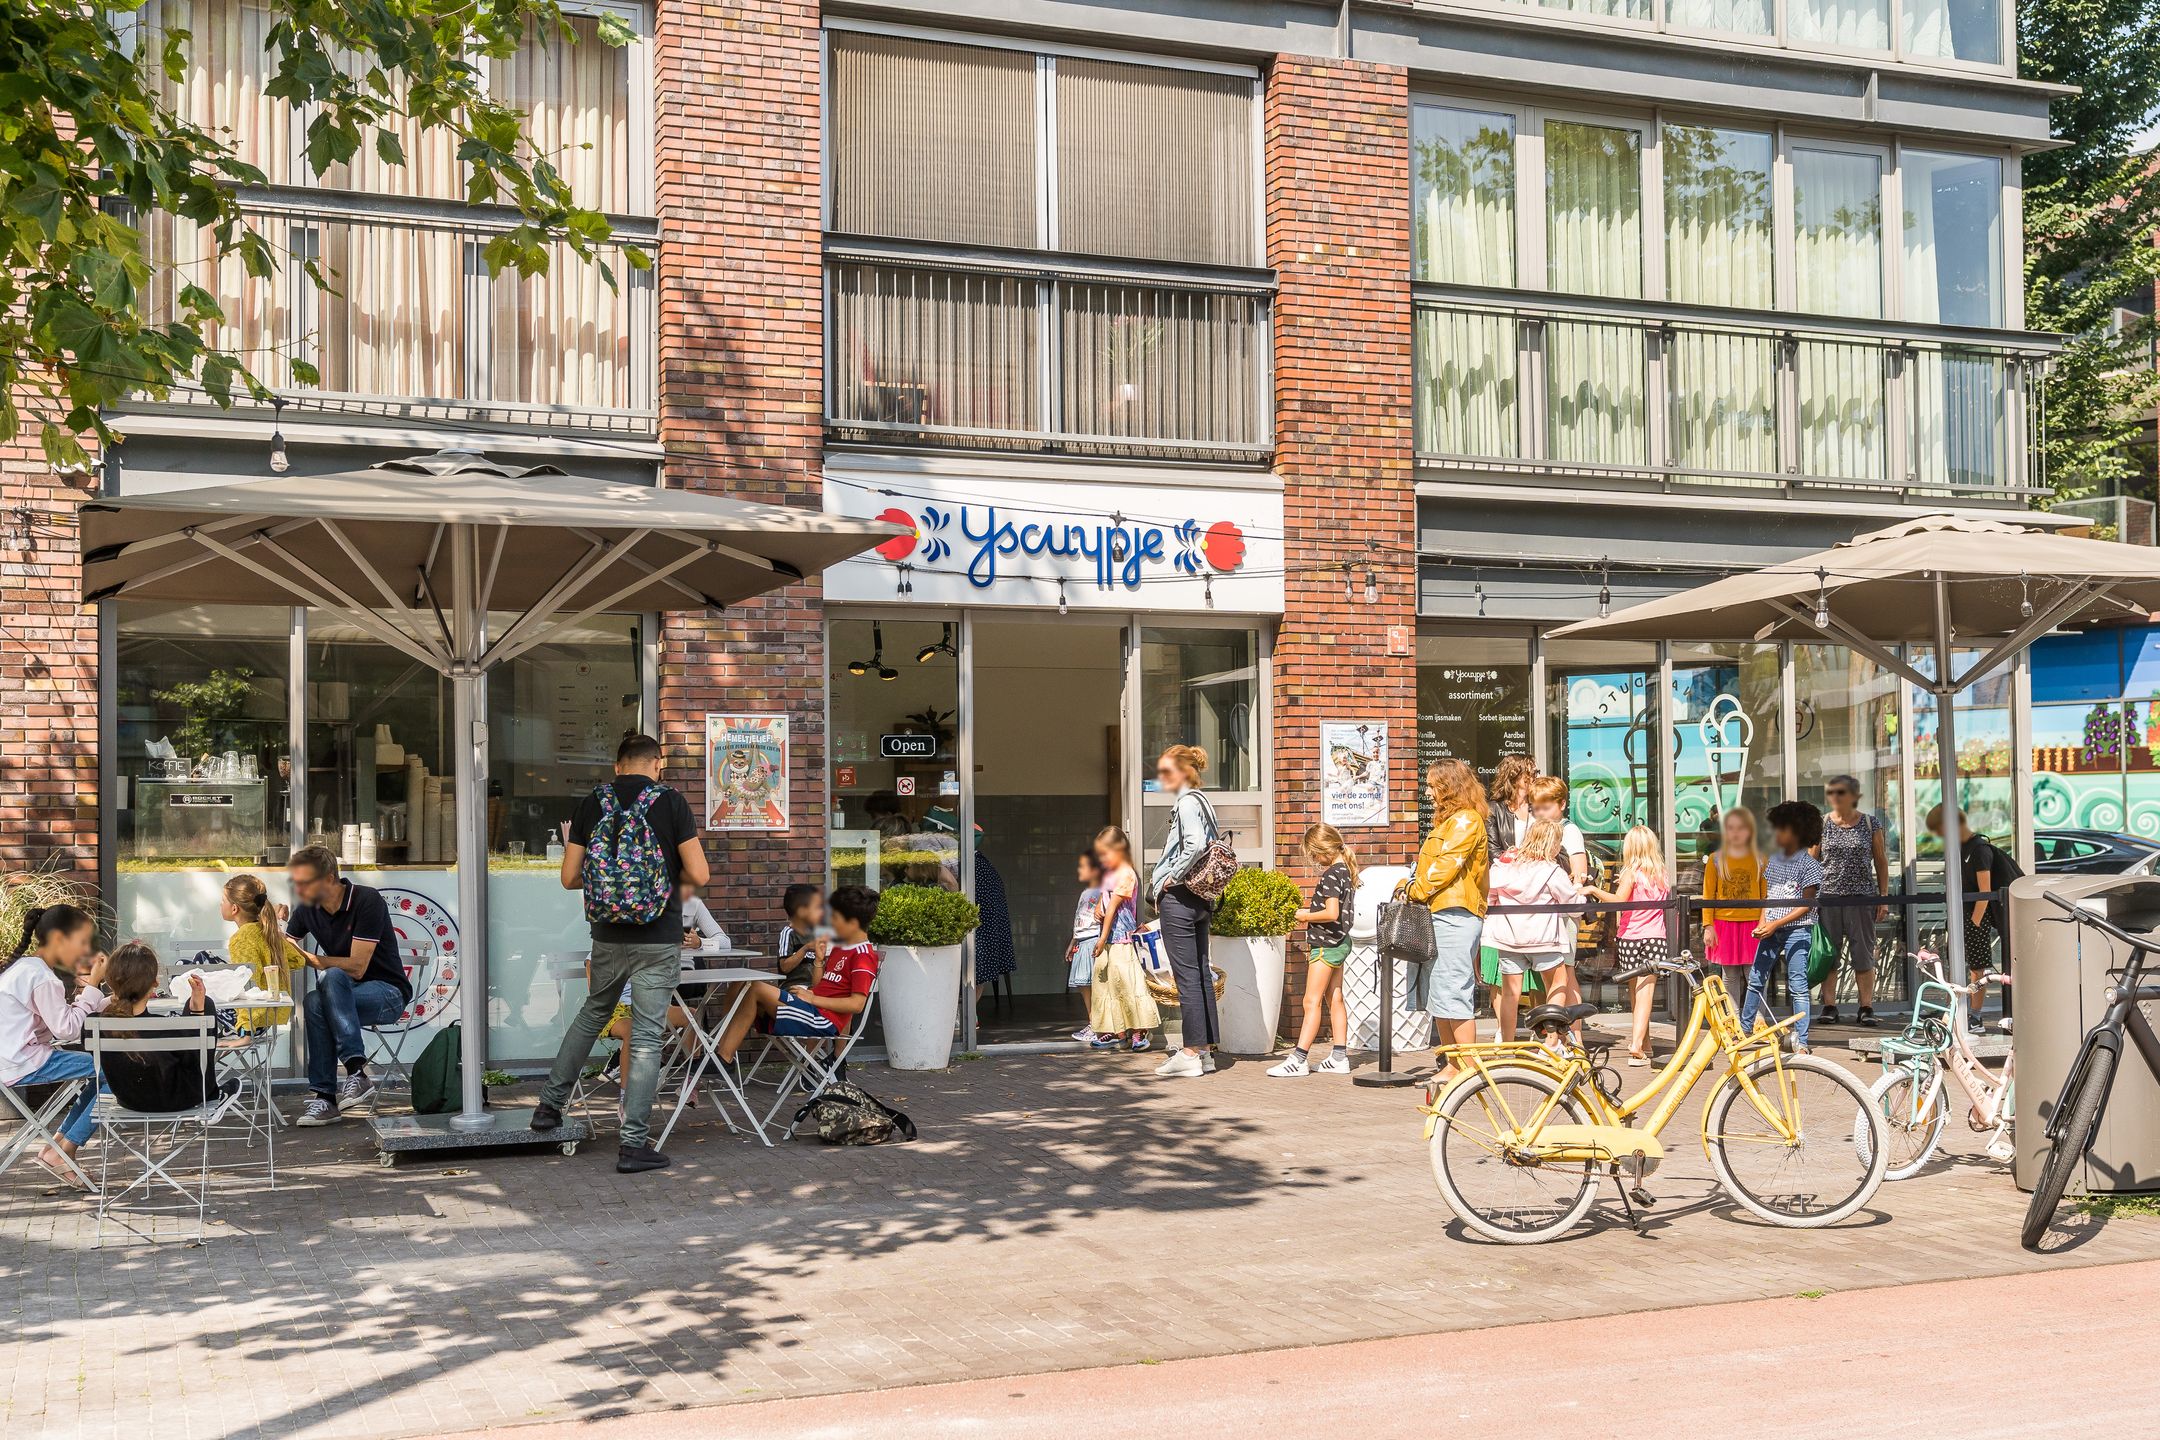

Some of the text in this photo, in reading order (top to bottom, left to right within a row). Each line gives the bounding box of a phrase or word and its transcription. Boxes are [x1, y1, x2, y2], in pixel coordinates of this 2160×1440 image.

[961, 506, 1164, 588] Yscuypje
[1448, 690, 1494, 700] assortiment
[1417, 713, 1462, 722] Room ijssmaken
[1478, 713, 1526, 722] Sorbet ijssmaken
[1417, 731, 1436, 739] Vanille
[1503, 731, 1526, 739] Aardbei
[891, 739, 926, 753] Open
[1504, 740, 1526, 748] Citroen
[1331, 791, 1346, 799] vier
[1347, 791, 1357, 799] de
[1348, 801, 1365, 809] ons!
